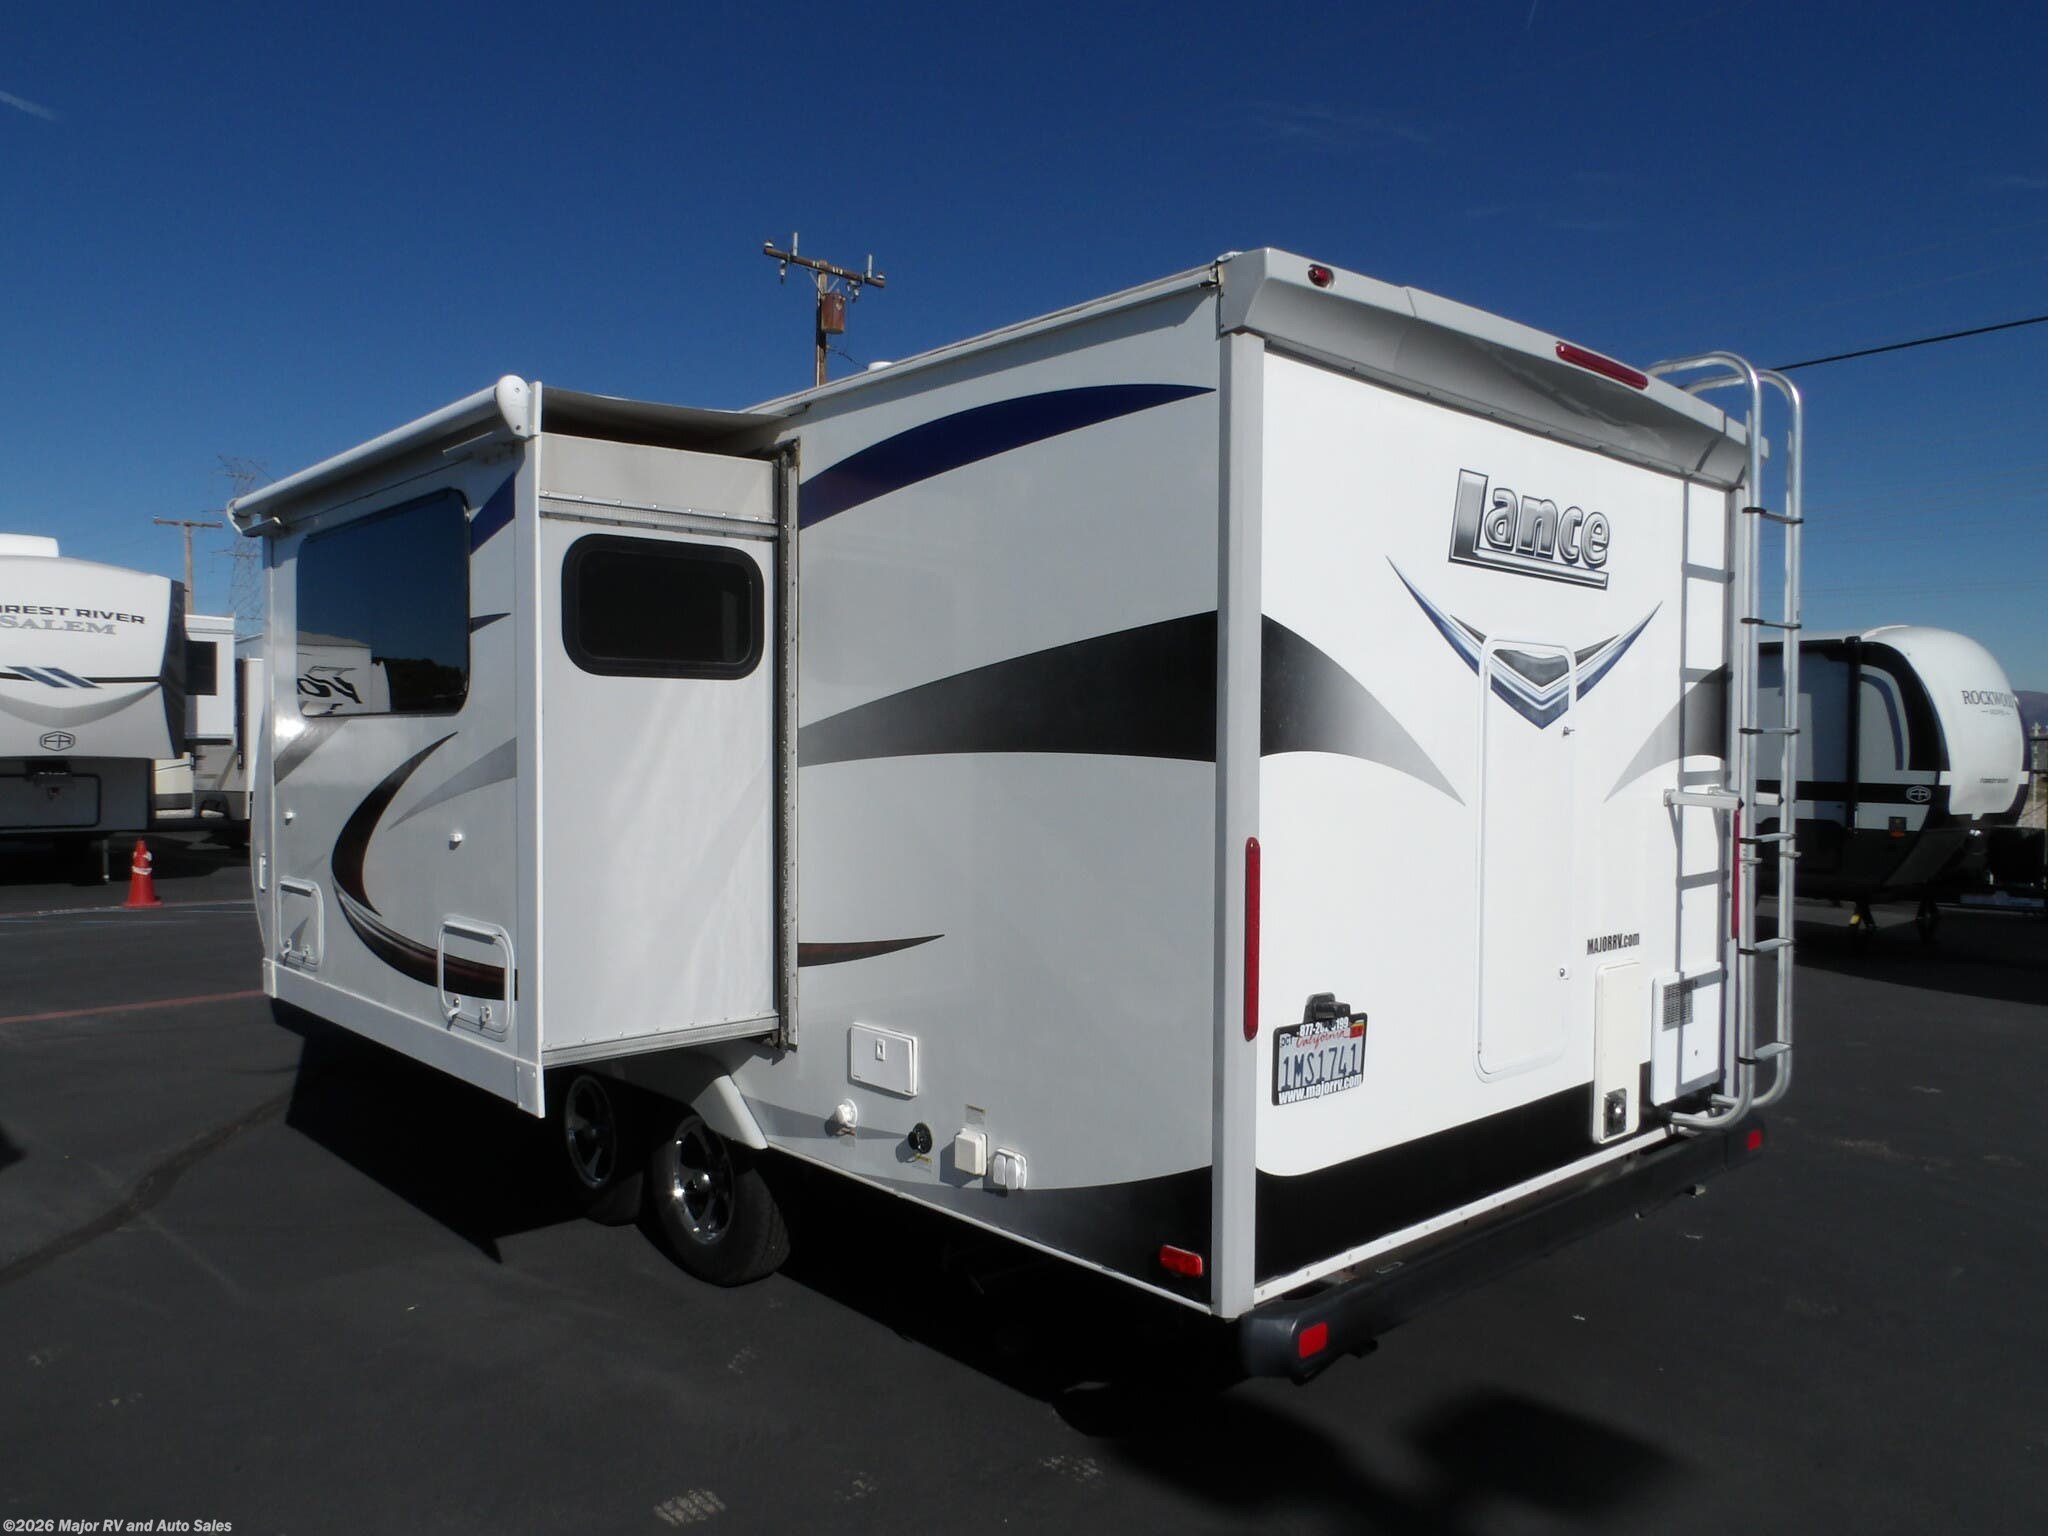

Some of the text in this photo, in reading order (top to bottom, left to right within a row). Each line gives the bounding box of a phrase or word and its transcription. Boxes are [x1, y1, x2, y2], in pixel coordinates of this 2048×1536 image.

[1448, 468, 1609, 591] Lance
[0, 605, 145, 624] REST RIVER
[0, 615, 116, 635] SALEM
[1586, 932, 1640, 955] MAJORRV.com
[1280, 1043, 1358, 1092] 1MS1741
[1278, 1074, 1362, 1104] www.majorrv.com
